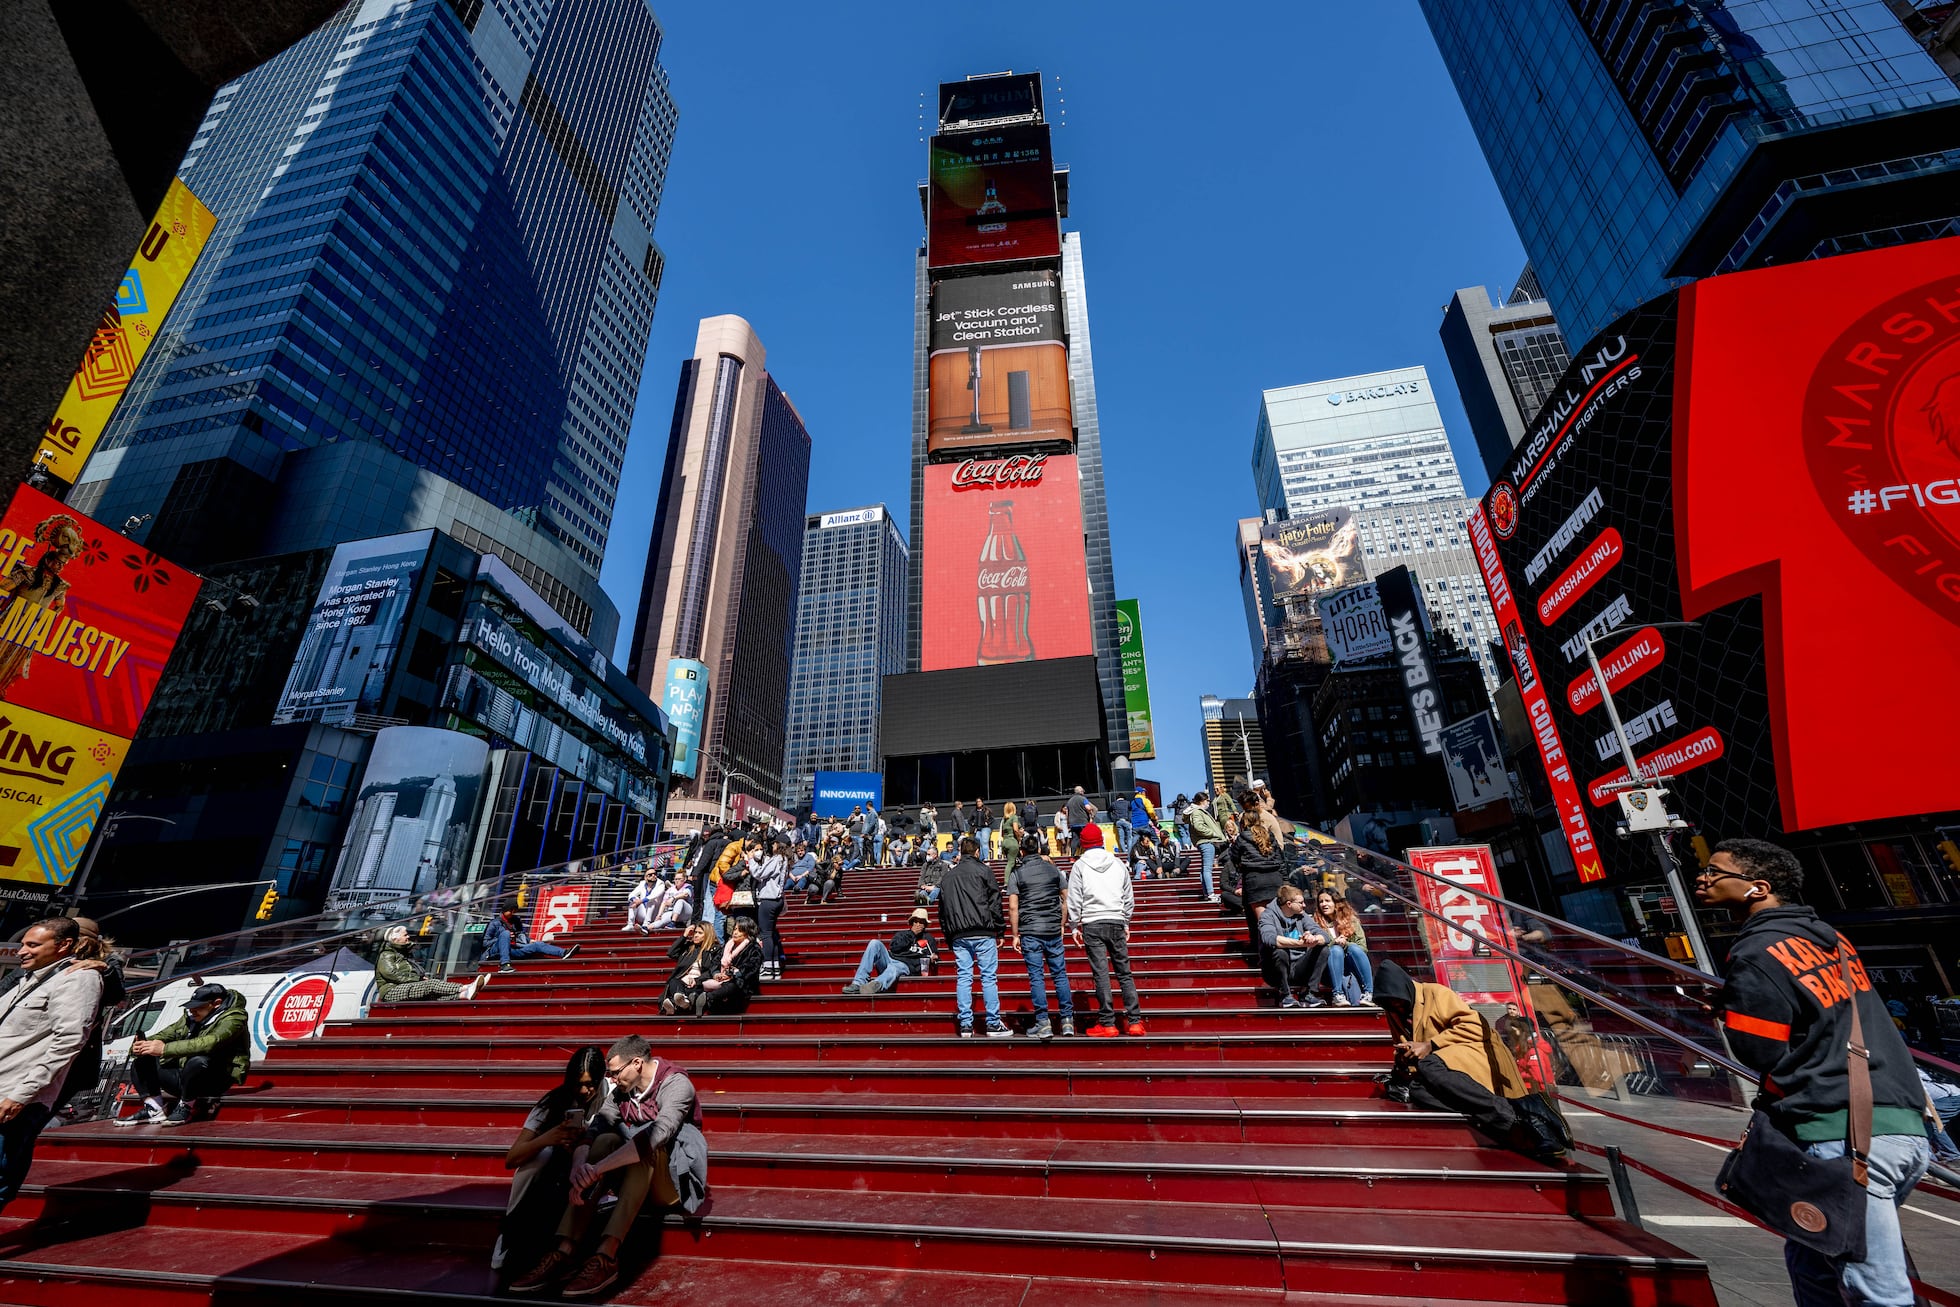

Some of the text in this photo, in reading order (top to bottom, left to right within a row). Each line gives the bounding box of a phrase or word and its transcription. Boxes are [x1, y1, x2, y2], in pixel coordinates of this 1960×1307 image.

[1012, 280, 1055, 290] SAMSUNG
[955, 314, 1036, 330] Vacuum and
[964, 308, 995, 319] Stick
[998, 304, 1055, 316] Cordless
[952, 330, 991, 341] Clean
[1345, 382, 1419, 403] BARCLAYS
[1512, 335, 1627, 486] MARSHALL INU
[1521, 366, 1642, 507] FIGHTING FOR FIGHTERS
[952, 452, 1048, 491] Coca-Cola
[1848, 477, 1960, 515] #FIG
[828, 513, 860, 526] Allianz
[1292, 512, 1329, 525] BROADWAY
[1524, 486, 1604, 586] INSTAGRAM
[358, 565, 382, 574] Stanley
[382, 562, 400, 570] Hong
[400, 560, 417, 568] Kong
[1468, 504, 1511, 611] CHOCOLATE
[328, 578, 400, 595] Morgan Stanley
[978, 565, 1029, 590] Coca-Cola
[1541, 541, 1619, 618] @MARSHALLINU_
[324, 588, 396, 606] has operated in
[1329, 586, 1372, 618] LITTLE
[316, 614, 366, 631] since 1987.
[320, 604, 372, 618] Hong Kong
[0, 596, 130, 678] MAJESTY
[1560, 593, 1634, 664] TWITTER
[1391, 610, 1442, 755] HE'S BACK
[1572, 640, 1660, 706] @MARHALLINU_
[478, 618, 512, 656] Hello
[513, 648, 540, 679] from
[541, 667, 578, 706] Morgan
[578, 696, 608, 733] Stanley
[608, 720, 629, 747] Hong
[628, 732, 646, 760] Kong
[1531, 698, 1563, 764] COME
[820, 789, 876, 800] INNOVATIVE
[1433, 856, 1490, 951] tkts
[284, 994, 324, 1008] COVID-19
[282, 1008, 320, 1022] TESTING
